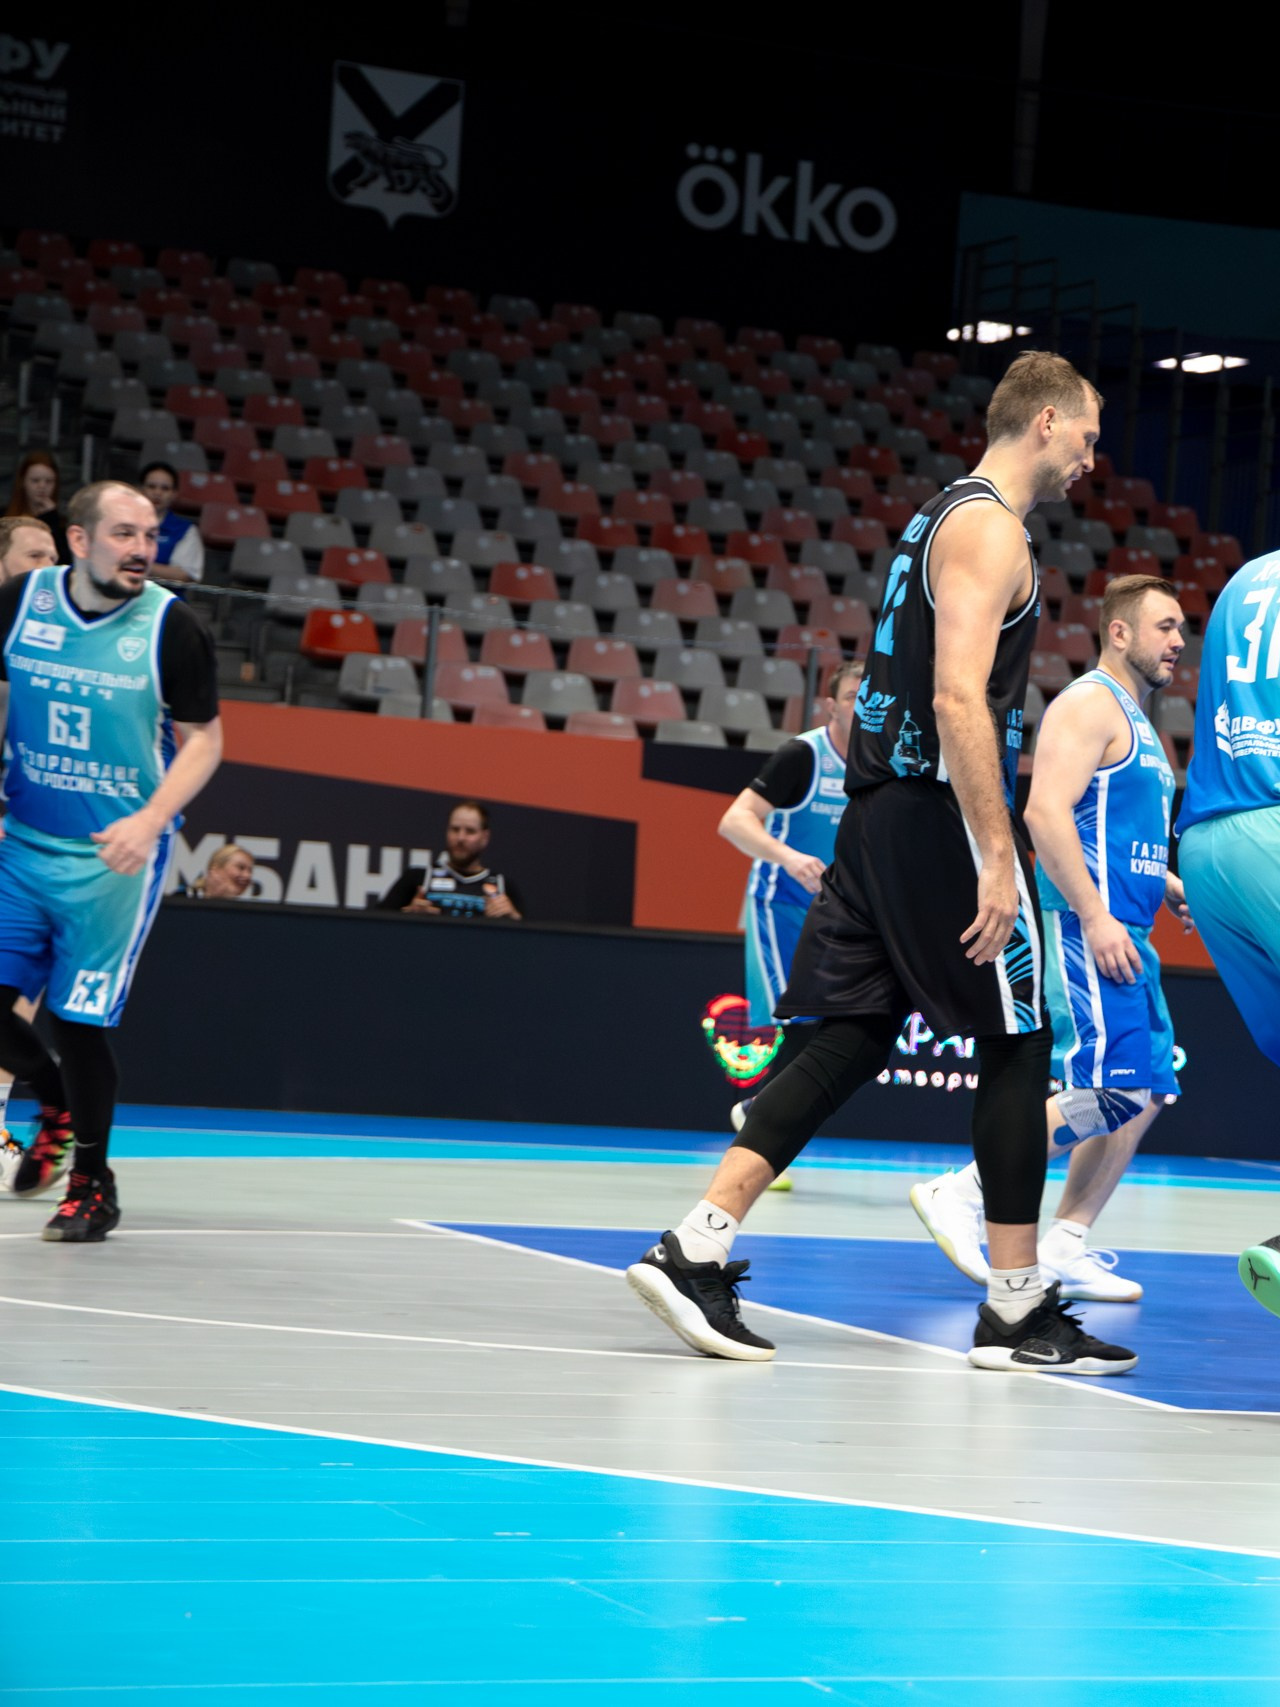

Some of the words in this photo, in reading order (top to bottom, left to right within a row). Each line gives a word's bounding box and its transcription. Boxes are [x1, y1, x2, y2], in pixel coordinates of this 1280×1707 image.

[30, 675, 113, 700] МАТЧ
[48, 700, 92, 751] 63
[64, 968, 112, 1015] 63
